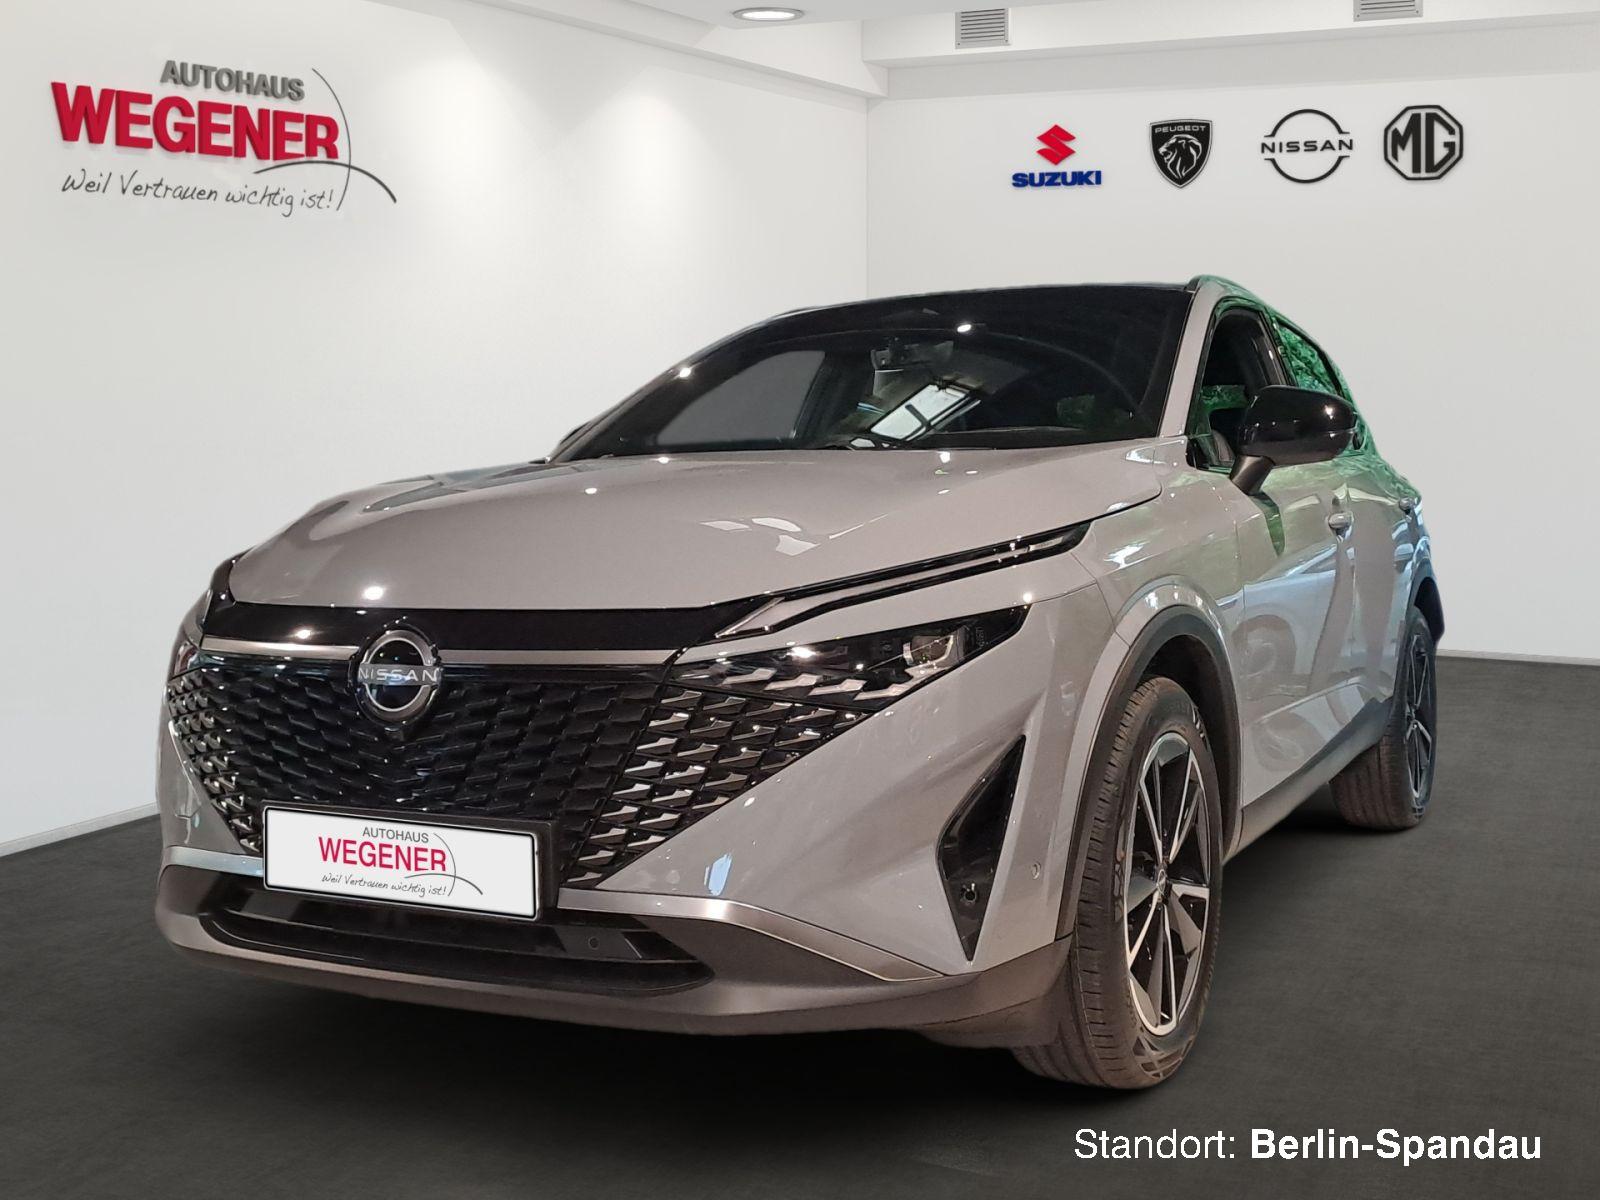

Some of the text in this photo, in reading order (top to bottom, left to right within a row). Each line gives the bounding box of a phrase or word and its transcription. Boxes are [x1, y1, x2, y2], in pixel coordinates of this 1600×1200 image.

[160, 60, 305, 101] AUTOHAUS
[51, 82, 339, 161] WEGENER
[1154, 125, 1206, 133] PEUGEOT
[1261, 139, 1353, 154] NISSAN
[1391, 112, 1456, 174] MG
[1011, 170, 1102, 188] SUZUKI
[62, 168, 334, 217] Weil Vertrauen wichtig ist!
[359, 667, 439, 682] NISSAN
[363, 827, 429, 843] AUTOHAUS
[318, 836, 446, 872] WEGENER
[322, 874, 446, 898] Weil Vertrauen wichtig ist!
